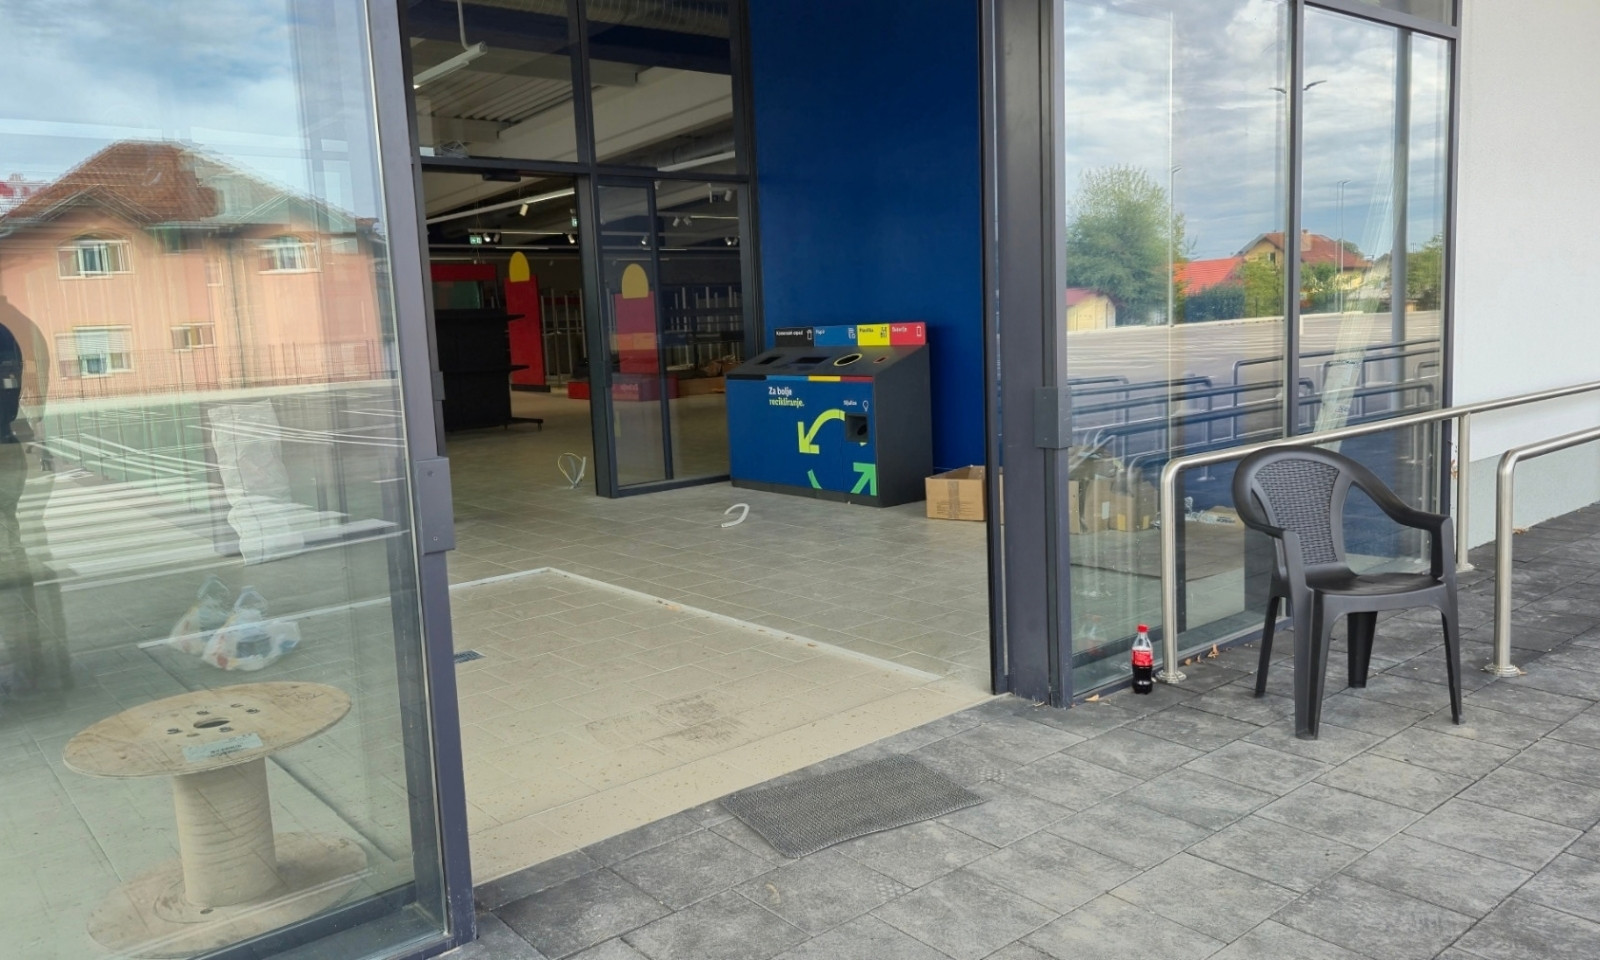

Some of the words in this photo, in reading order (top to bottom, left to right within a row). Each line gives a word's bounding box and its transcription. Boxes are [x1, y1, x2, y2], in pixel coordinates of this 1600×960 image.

[768, 386, 776, 395] Za
[776, 386, 792, 397] bolje
[769, 396, 805, 409] recikliranje.
